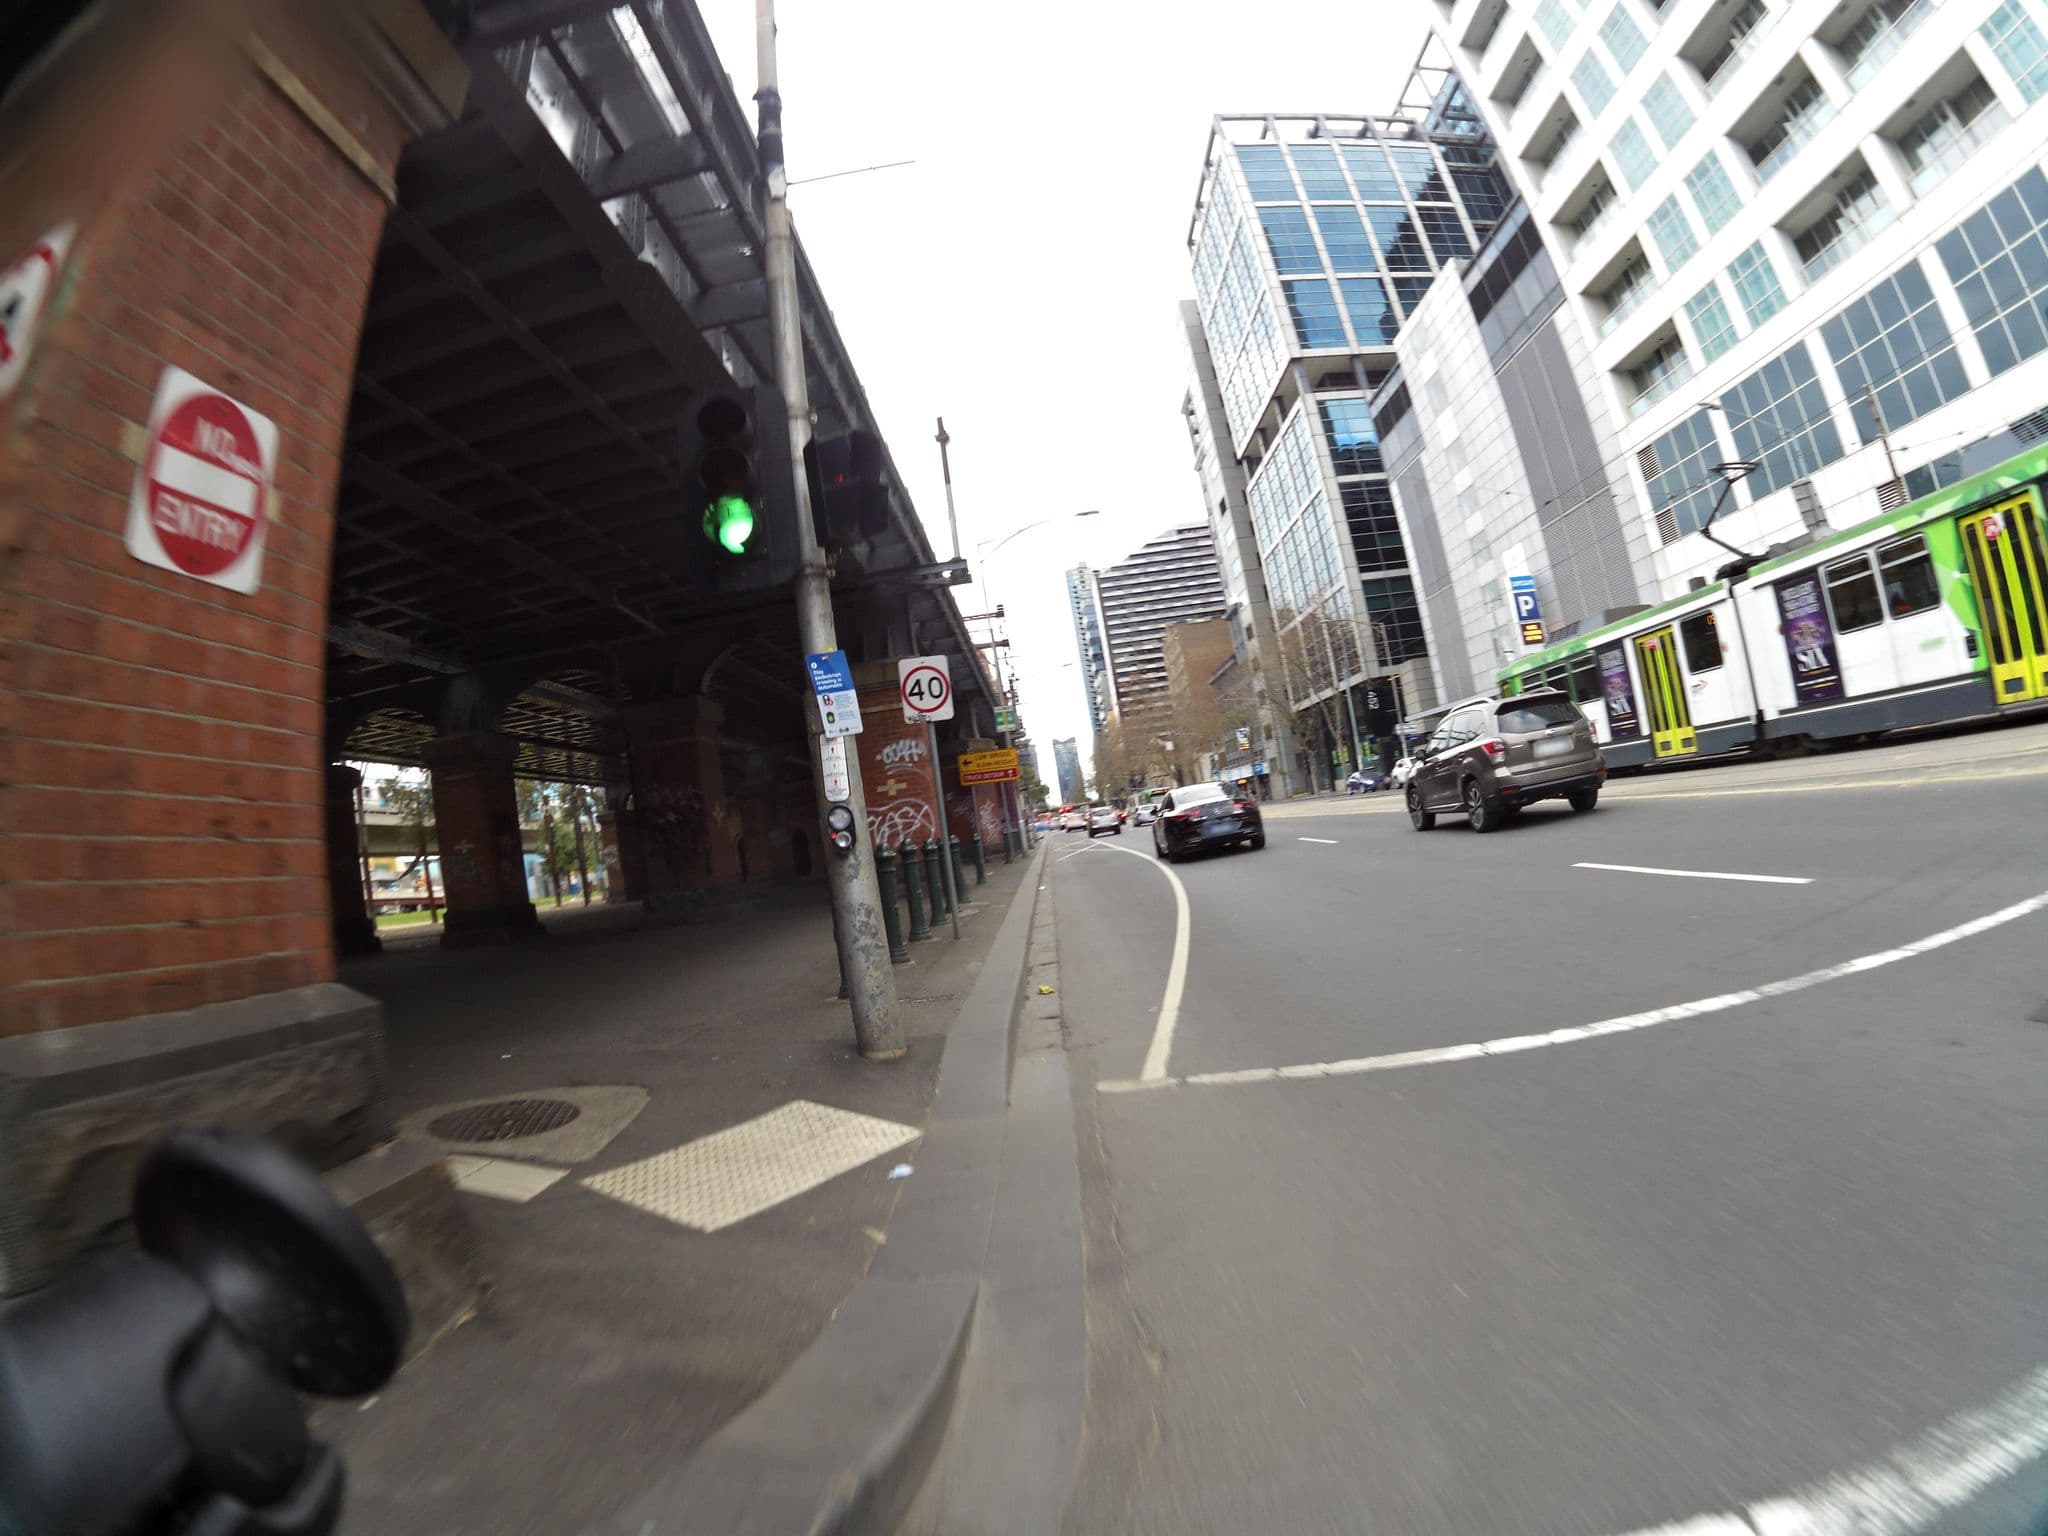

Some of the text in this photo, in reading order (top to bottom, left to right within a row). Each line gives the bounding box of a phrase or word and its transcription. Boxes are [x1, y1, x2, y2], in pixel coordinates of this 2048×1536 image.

[193, 416, 238, 458] NO
[153, 490, 249, 553] ENTRY
[1517, 595, 1535, 617] P
[818, 682, 843, 690] automatic
[908, 676, 944, 701] 40
